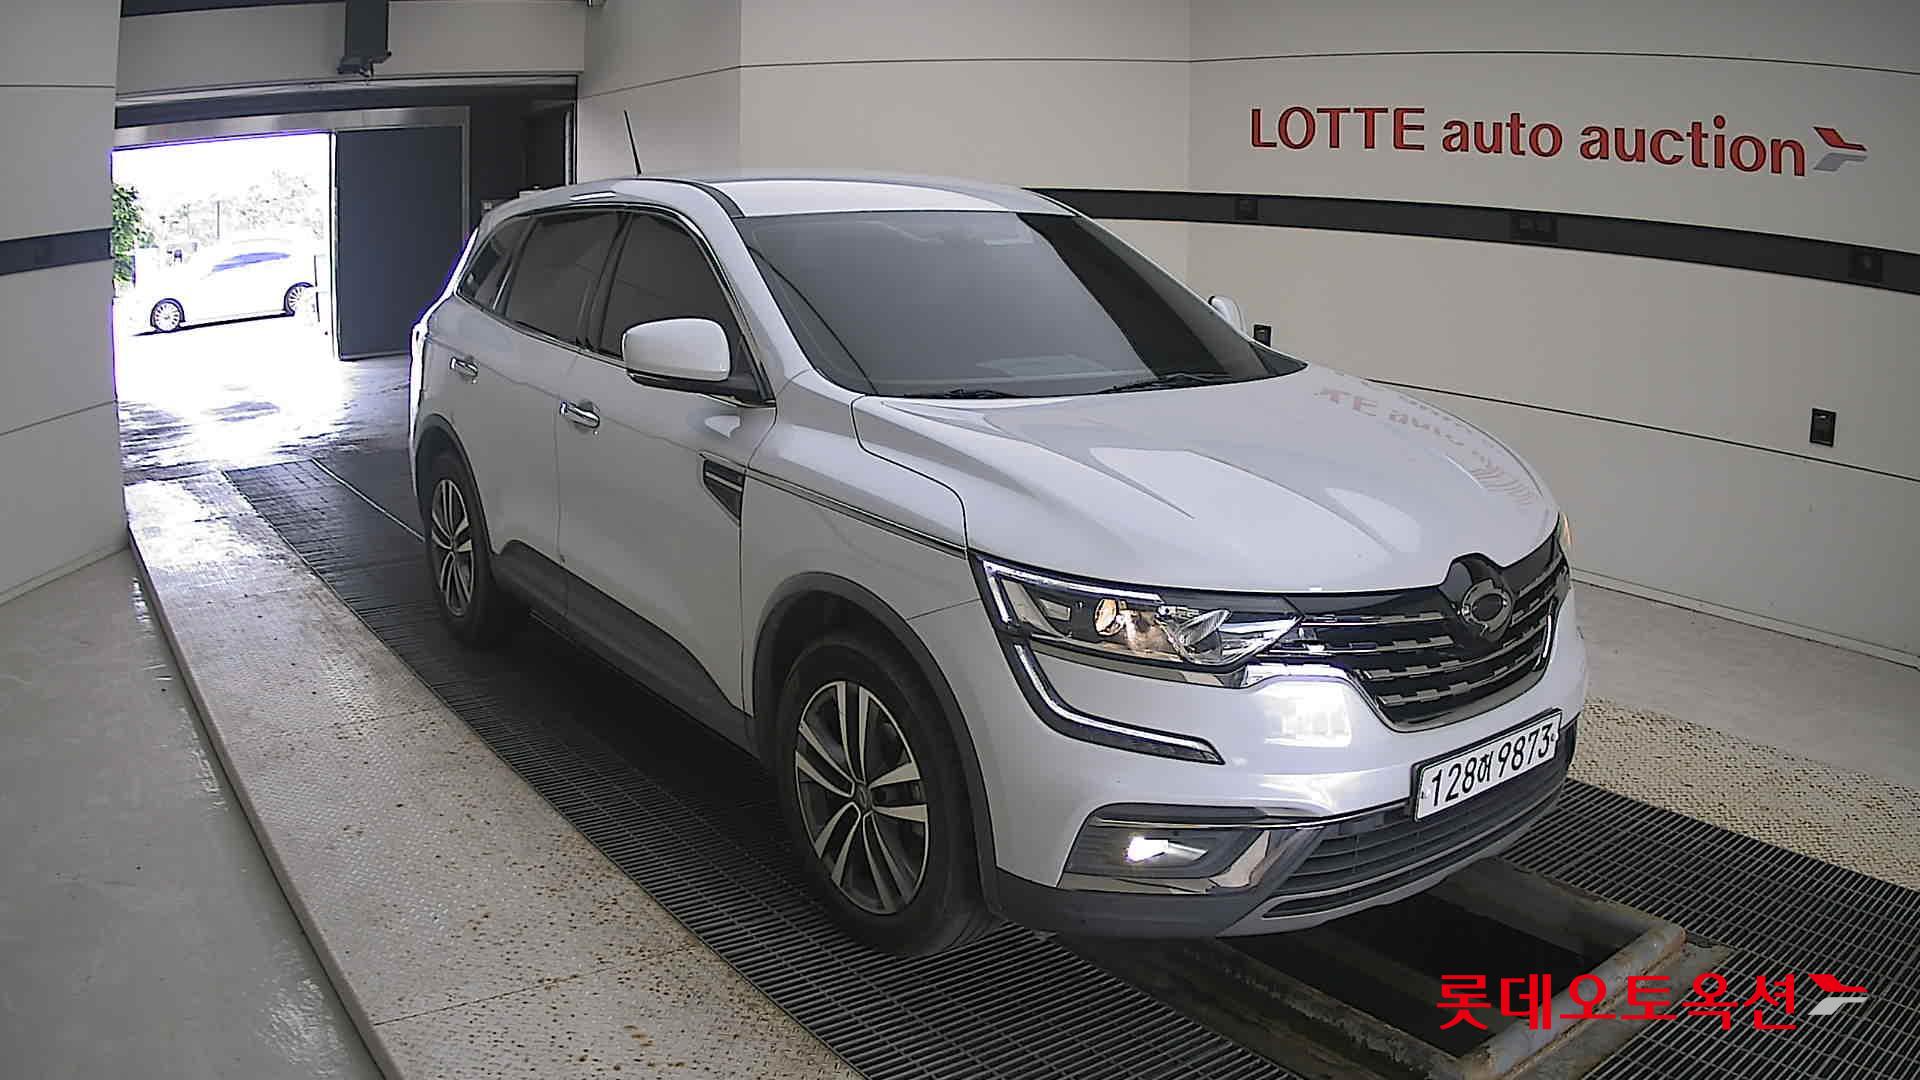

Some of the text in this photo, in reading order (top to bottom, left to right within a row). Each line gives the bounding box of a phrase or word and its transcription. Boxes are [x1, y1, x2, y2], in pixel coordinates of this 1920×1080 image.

[1251, 106, 1806, 177] LOTTE auto auction
[1498, 723, 1553, 778] 9873
